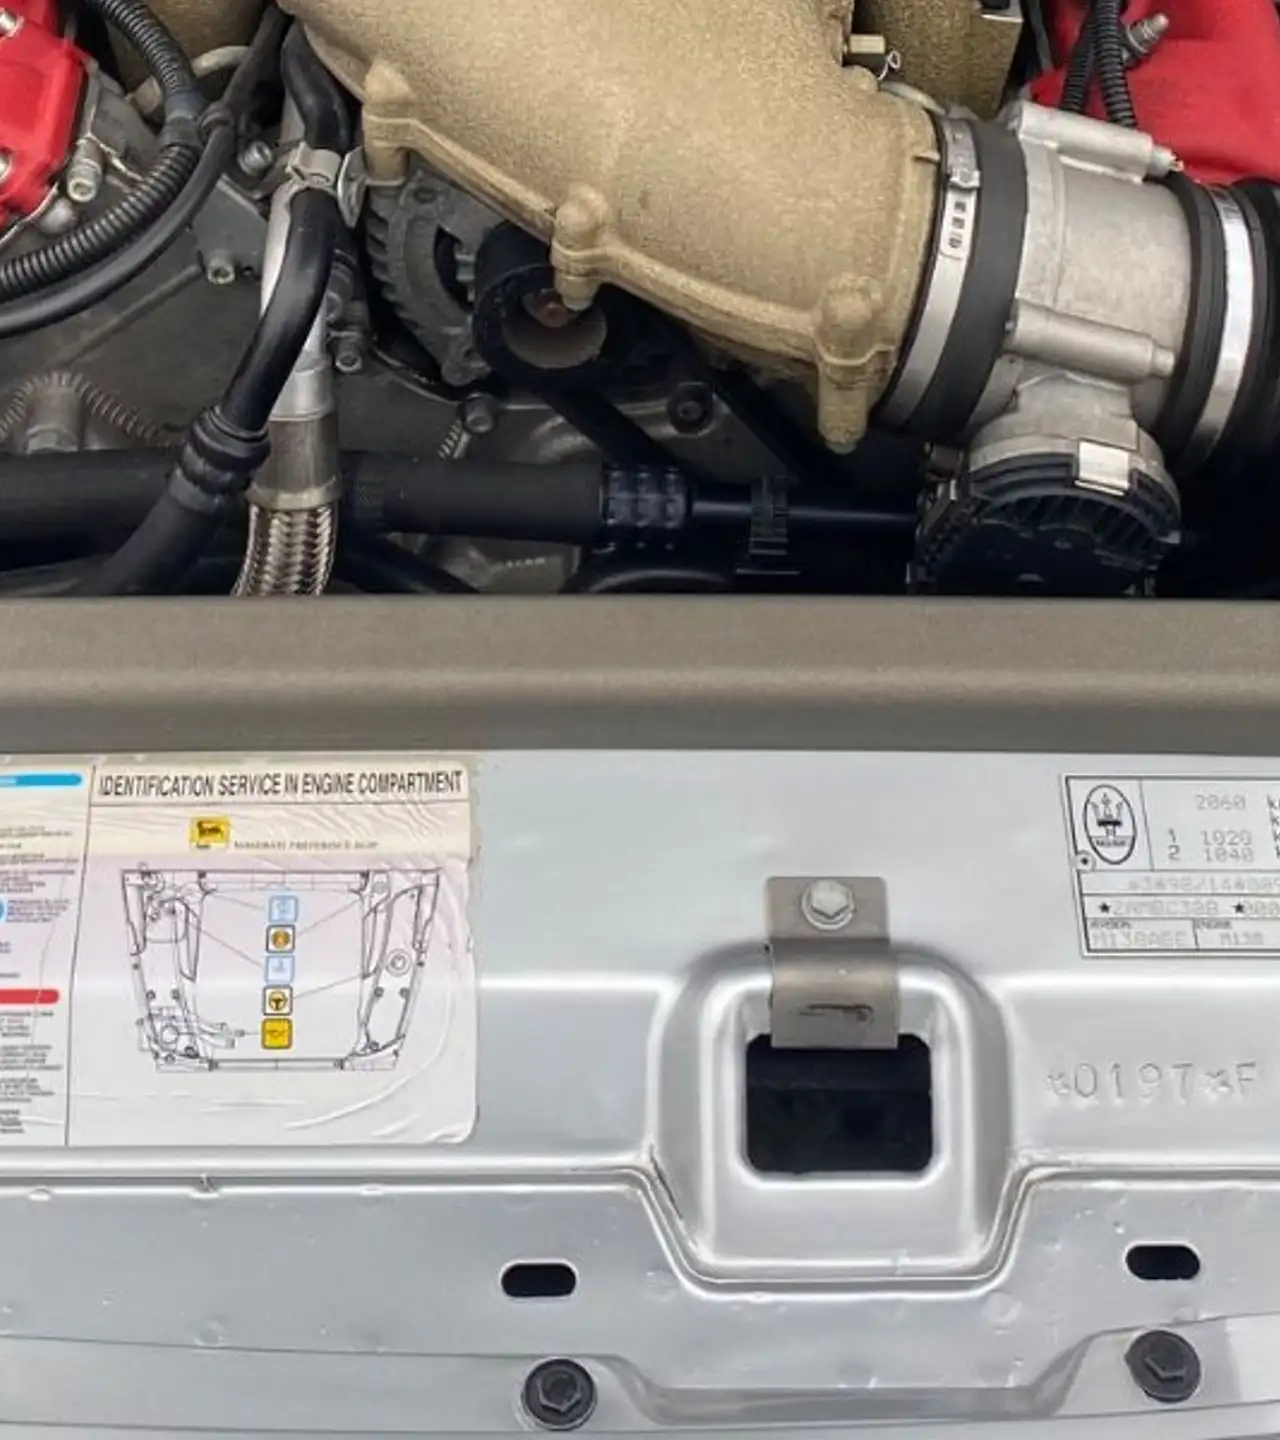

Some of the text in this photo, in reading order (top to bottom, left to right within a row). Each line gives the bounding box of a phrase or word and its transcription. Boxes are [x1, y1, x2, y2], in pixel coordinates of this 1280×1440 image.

[99, 770, 463, 797] IDENTIFICATION SERVICE IN ENGINE COMPARTMENT
[1168, 844, 1181, 861] 2
